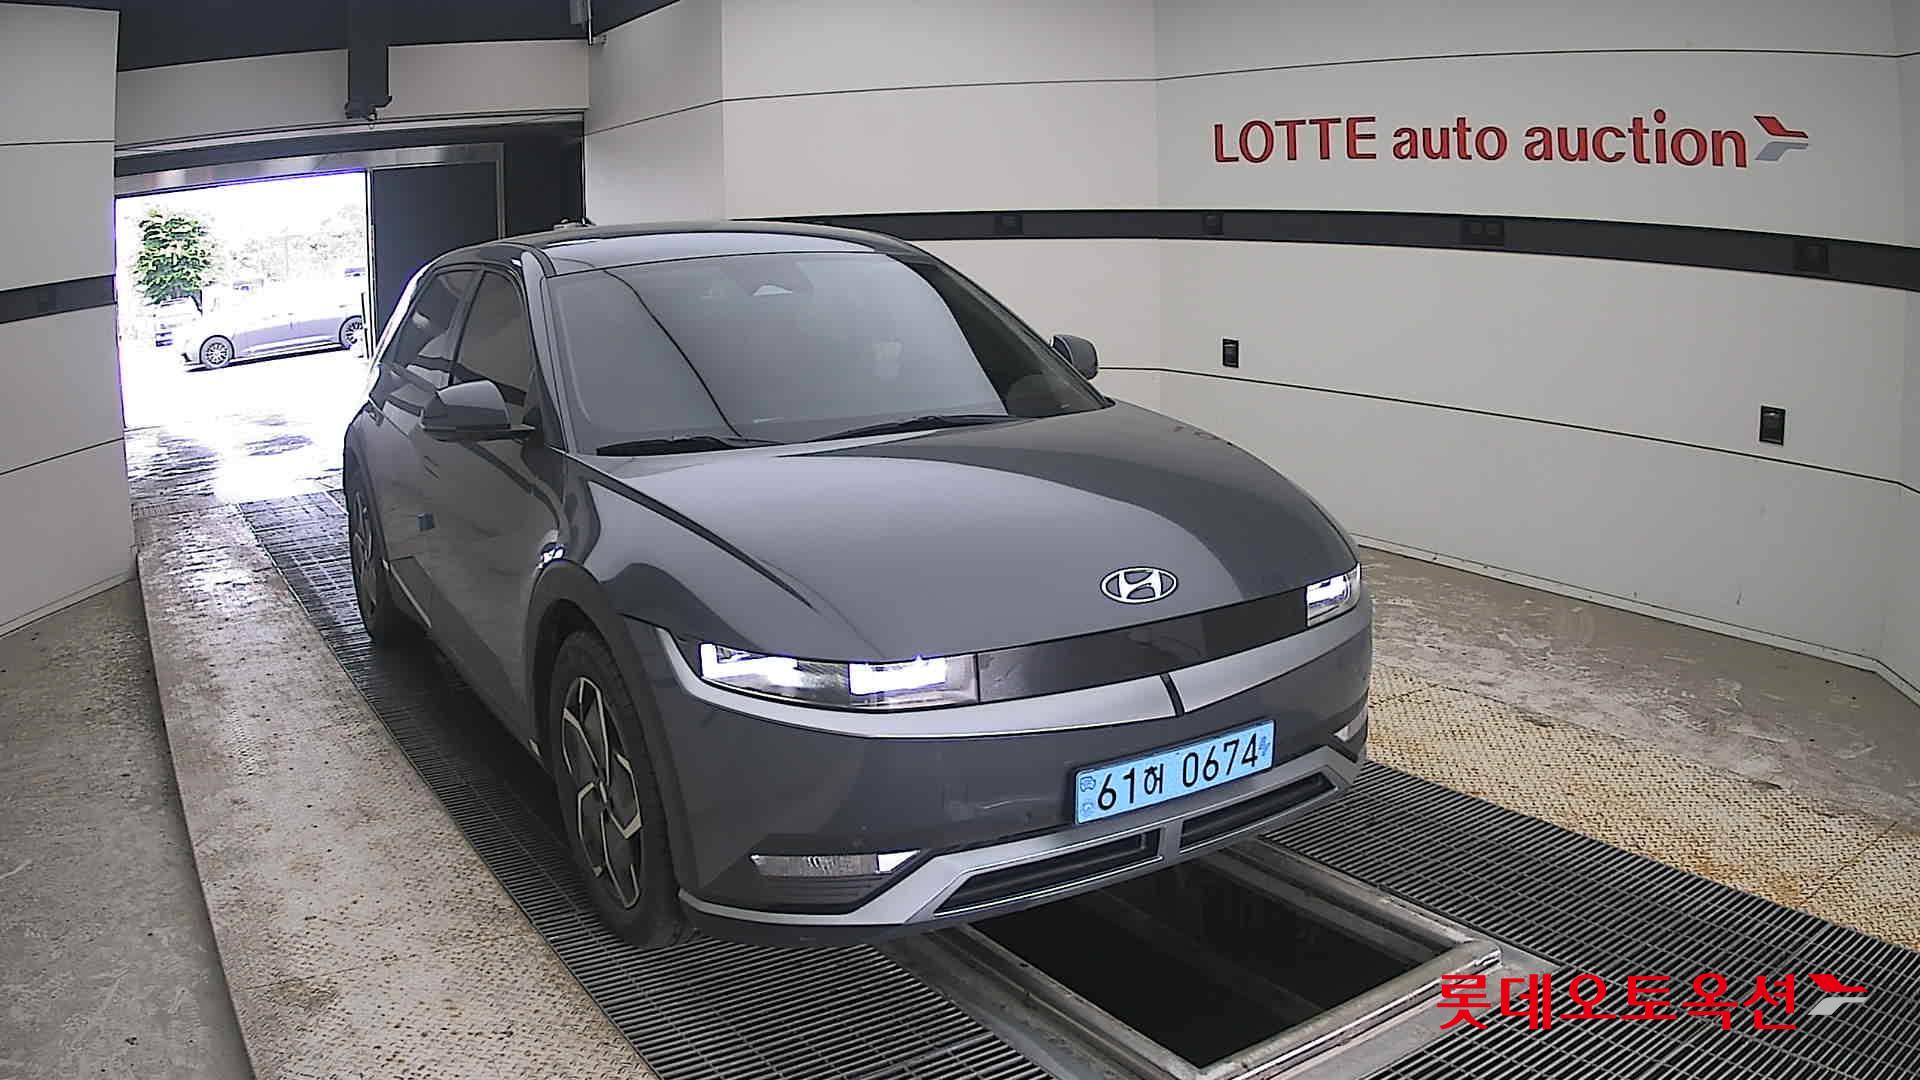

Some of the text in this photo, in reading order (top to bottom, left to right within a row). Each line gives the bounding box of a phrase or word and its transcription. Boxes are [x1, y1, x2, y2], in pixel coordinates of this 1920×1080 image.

[1213, 109, 1748, 169] LOTTE auto auction
[1097, 763, 1165, 811] 61허
[1181, 732, 1259, 789] 0674
